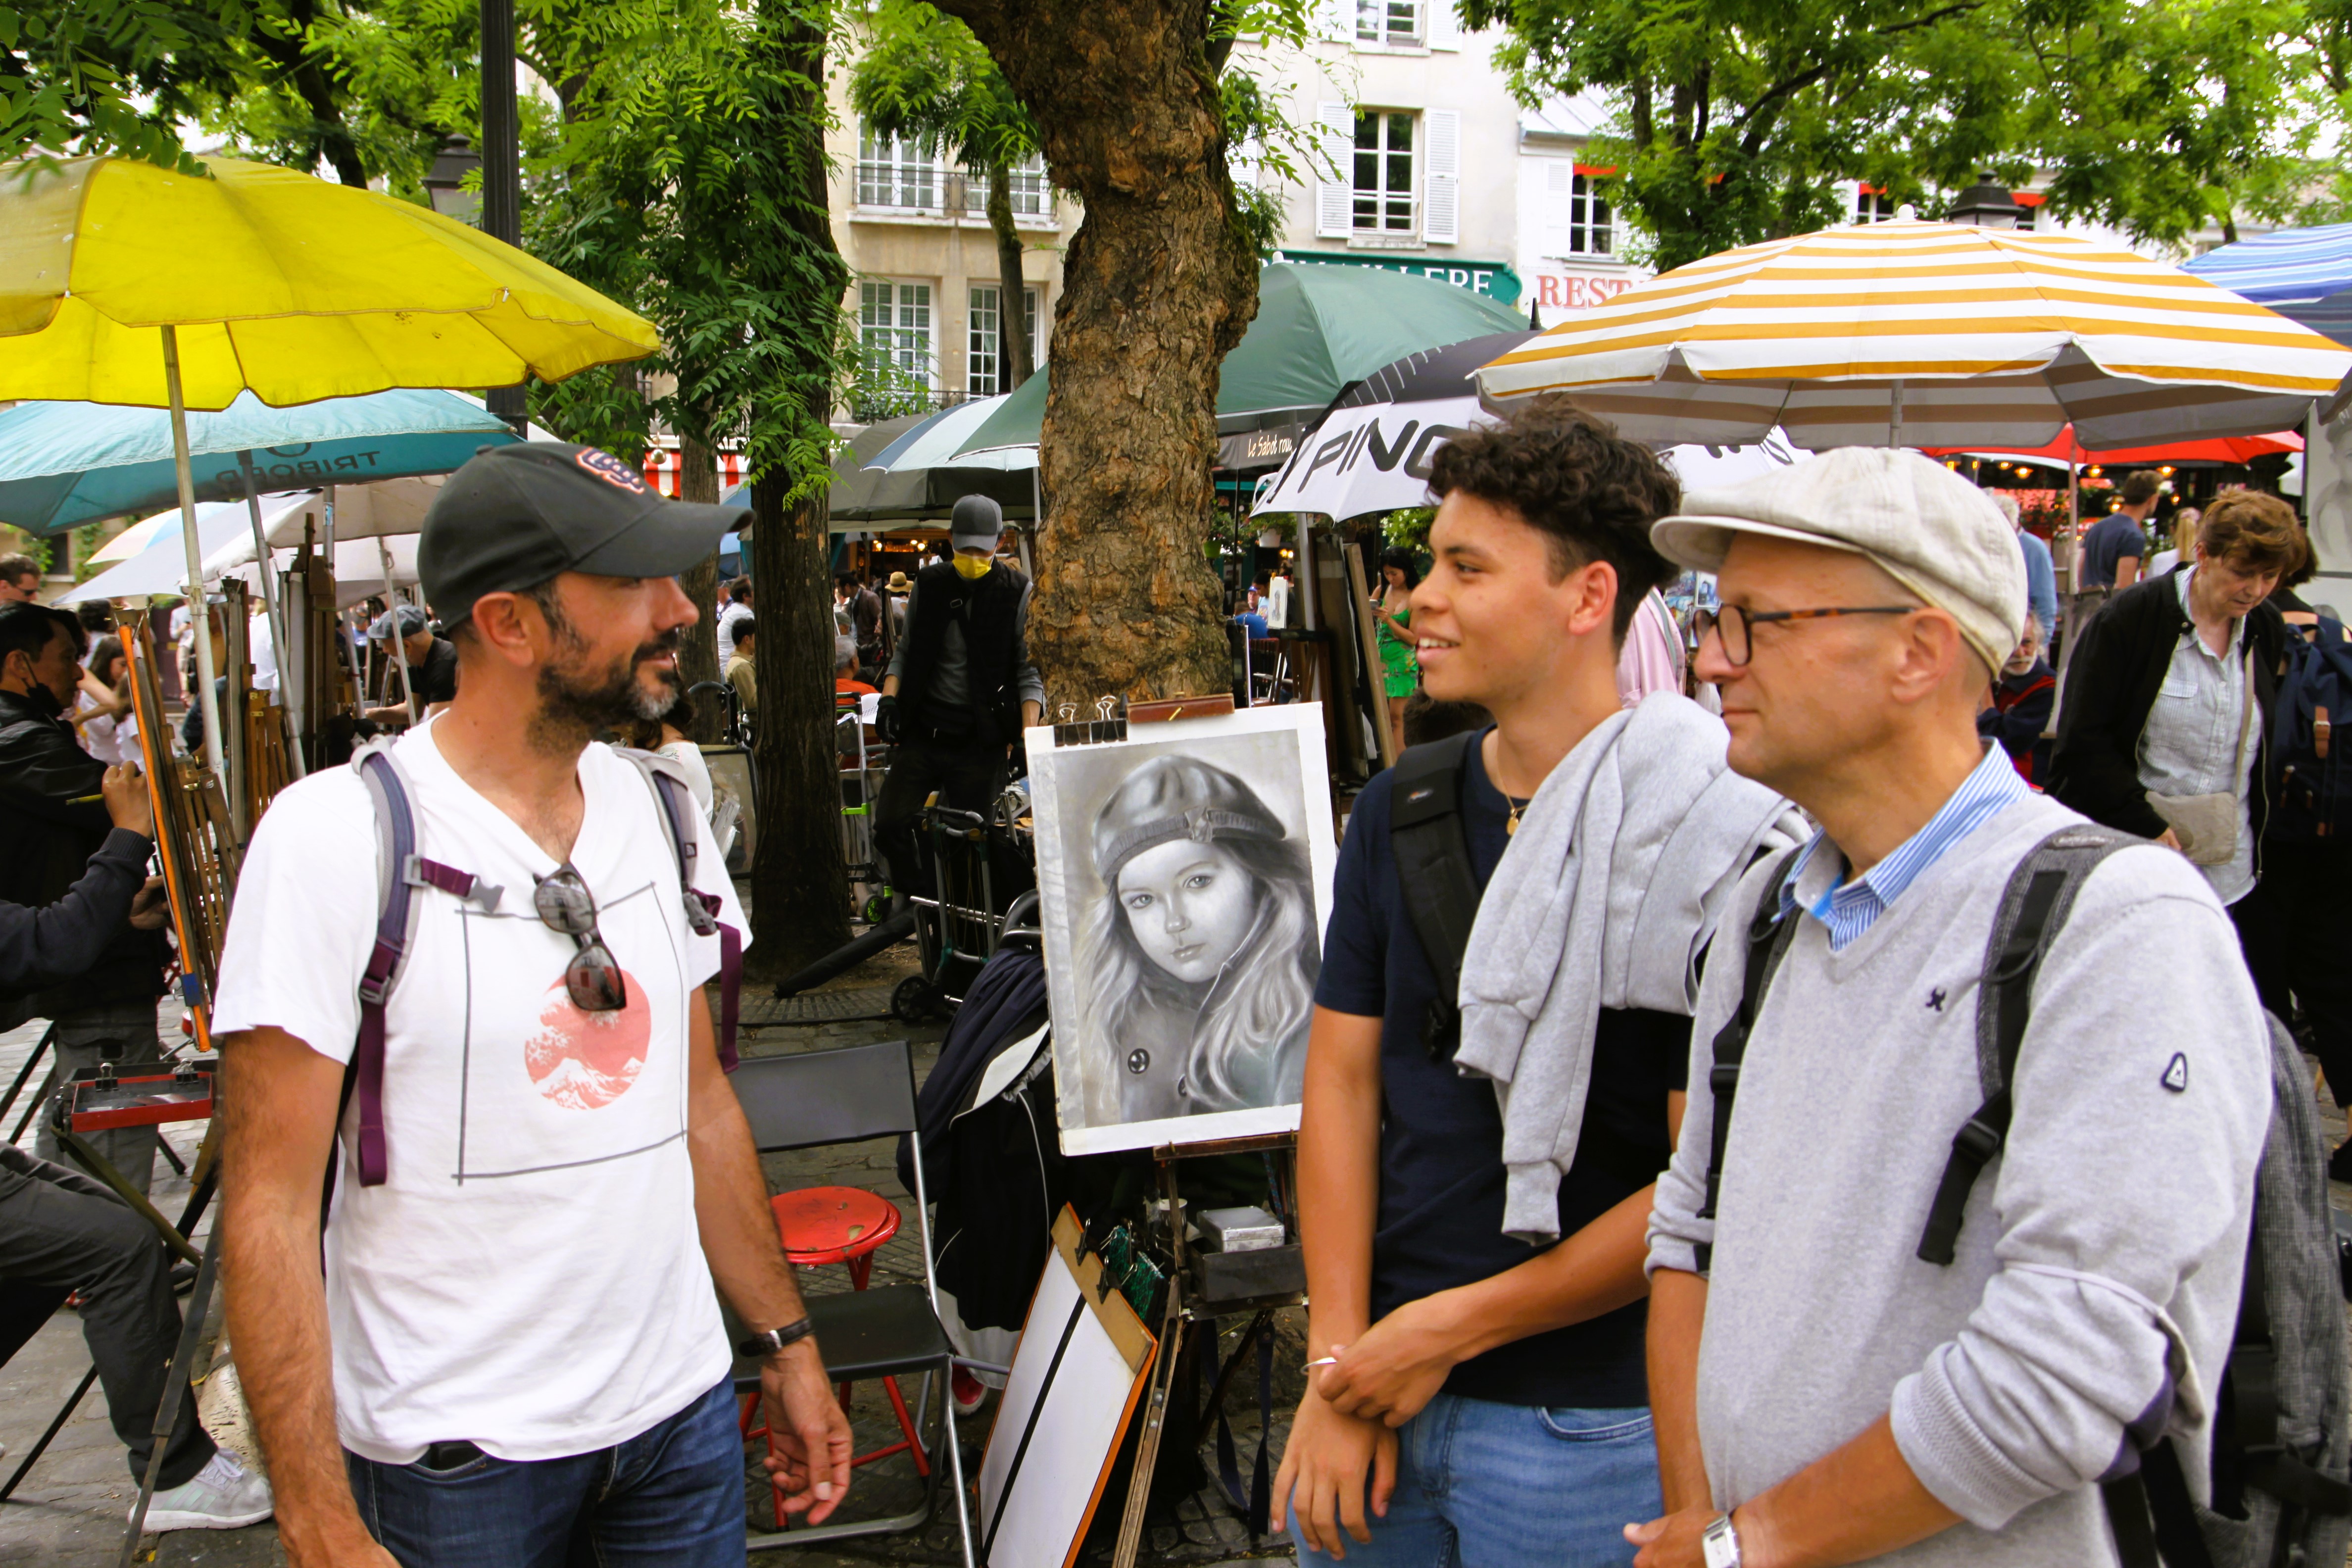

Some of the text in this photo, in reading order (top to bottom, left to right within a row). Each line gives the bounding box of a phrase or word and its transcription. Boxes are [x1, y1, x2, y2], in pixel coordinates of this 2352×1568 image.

[1536, 275, 1644, 309] REST
[1248, 438, 1257, 458] Le
[1257, 434, 1278, 457] Sabot
